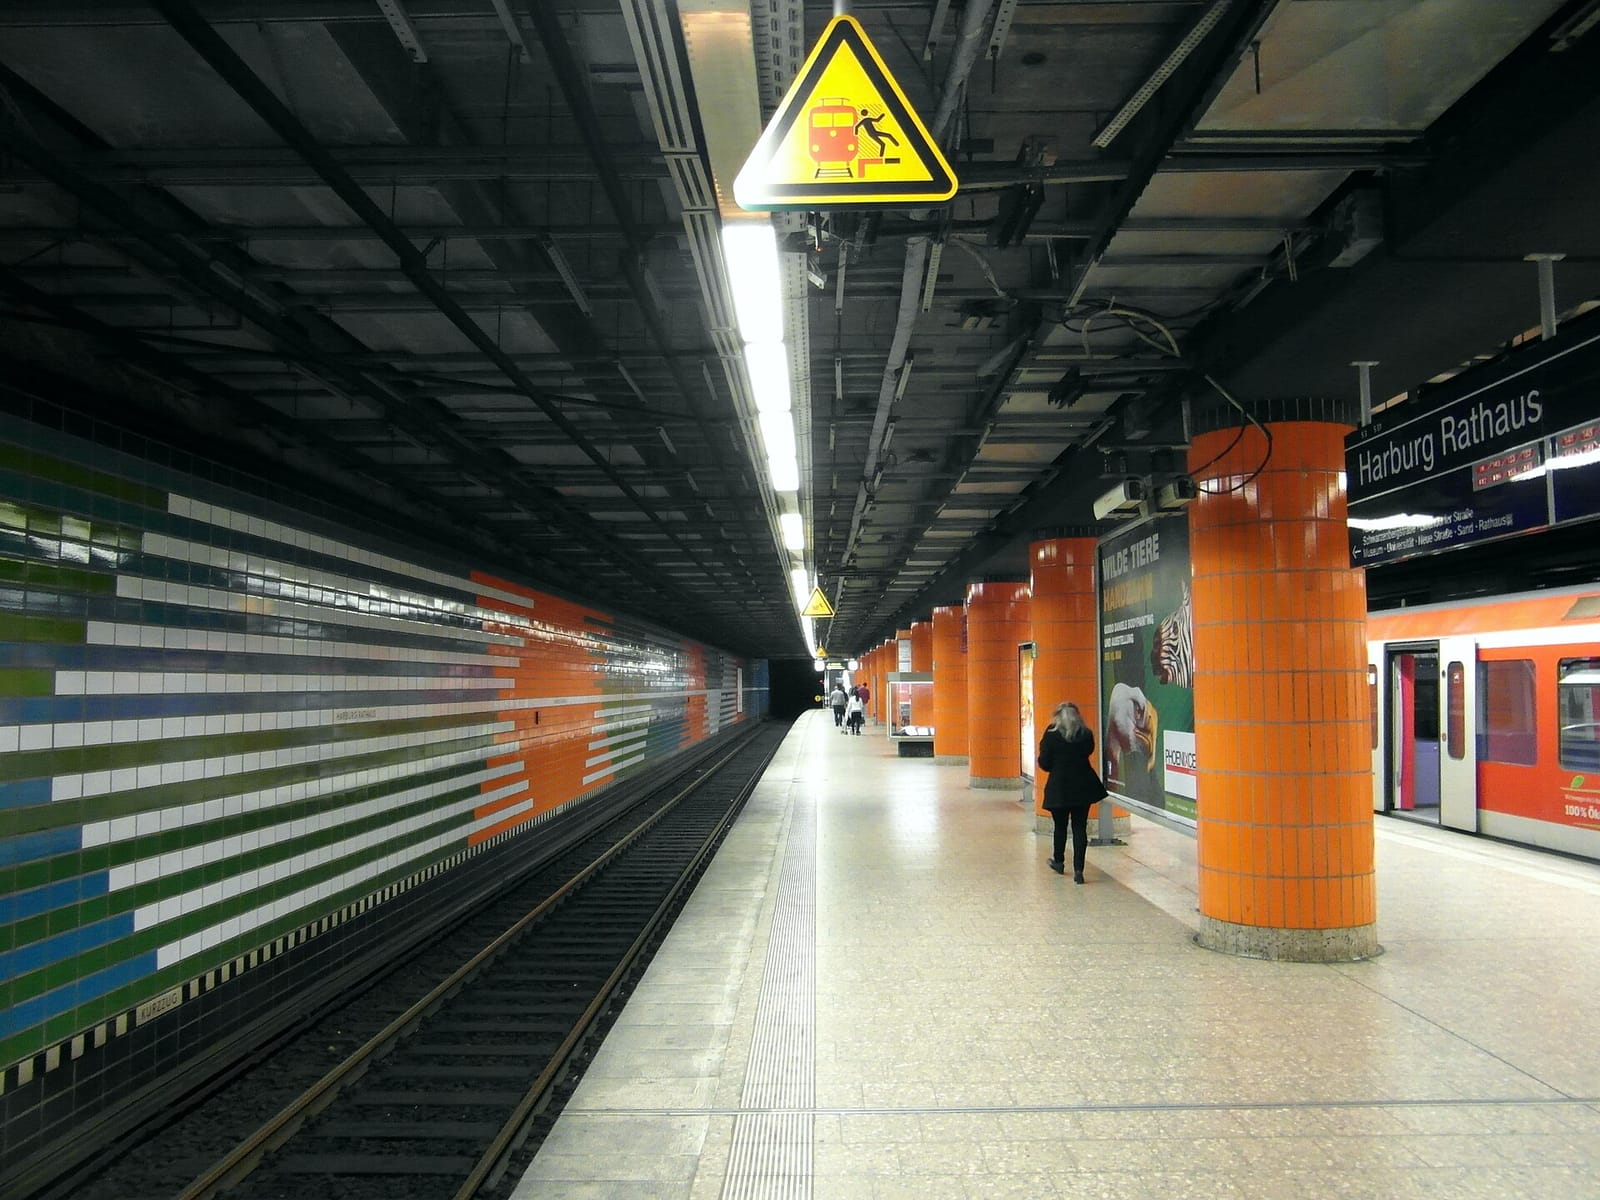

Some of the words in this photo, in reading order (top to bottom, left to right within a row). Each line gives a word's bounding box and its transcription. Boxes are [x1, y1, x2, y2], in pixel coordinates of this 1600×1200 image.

[1358, 431, 1434, 486] Harburg
[1441, 389, 1543, 456] Rathaus
[1363, 546, 1384, 558] Museum
[1418, 533, 1433, 546] Neue
[1434, 527, 1454, 542] Straße
[1457, 522, 1474, 536] Sand
[1479, 516, 1507, 532] Rathaus
[1453, 507, 1474, 522] Straße
[1102, 547, 1128, 581] WILDE
[1130, 533, 1160, 569] TIERE
